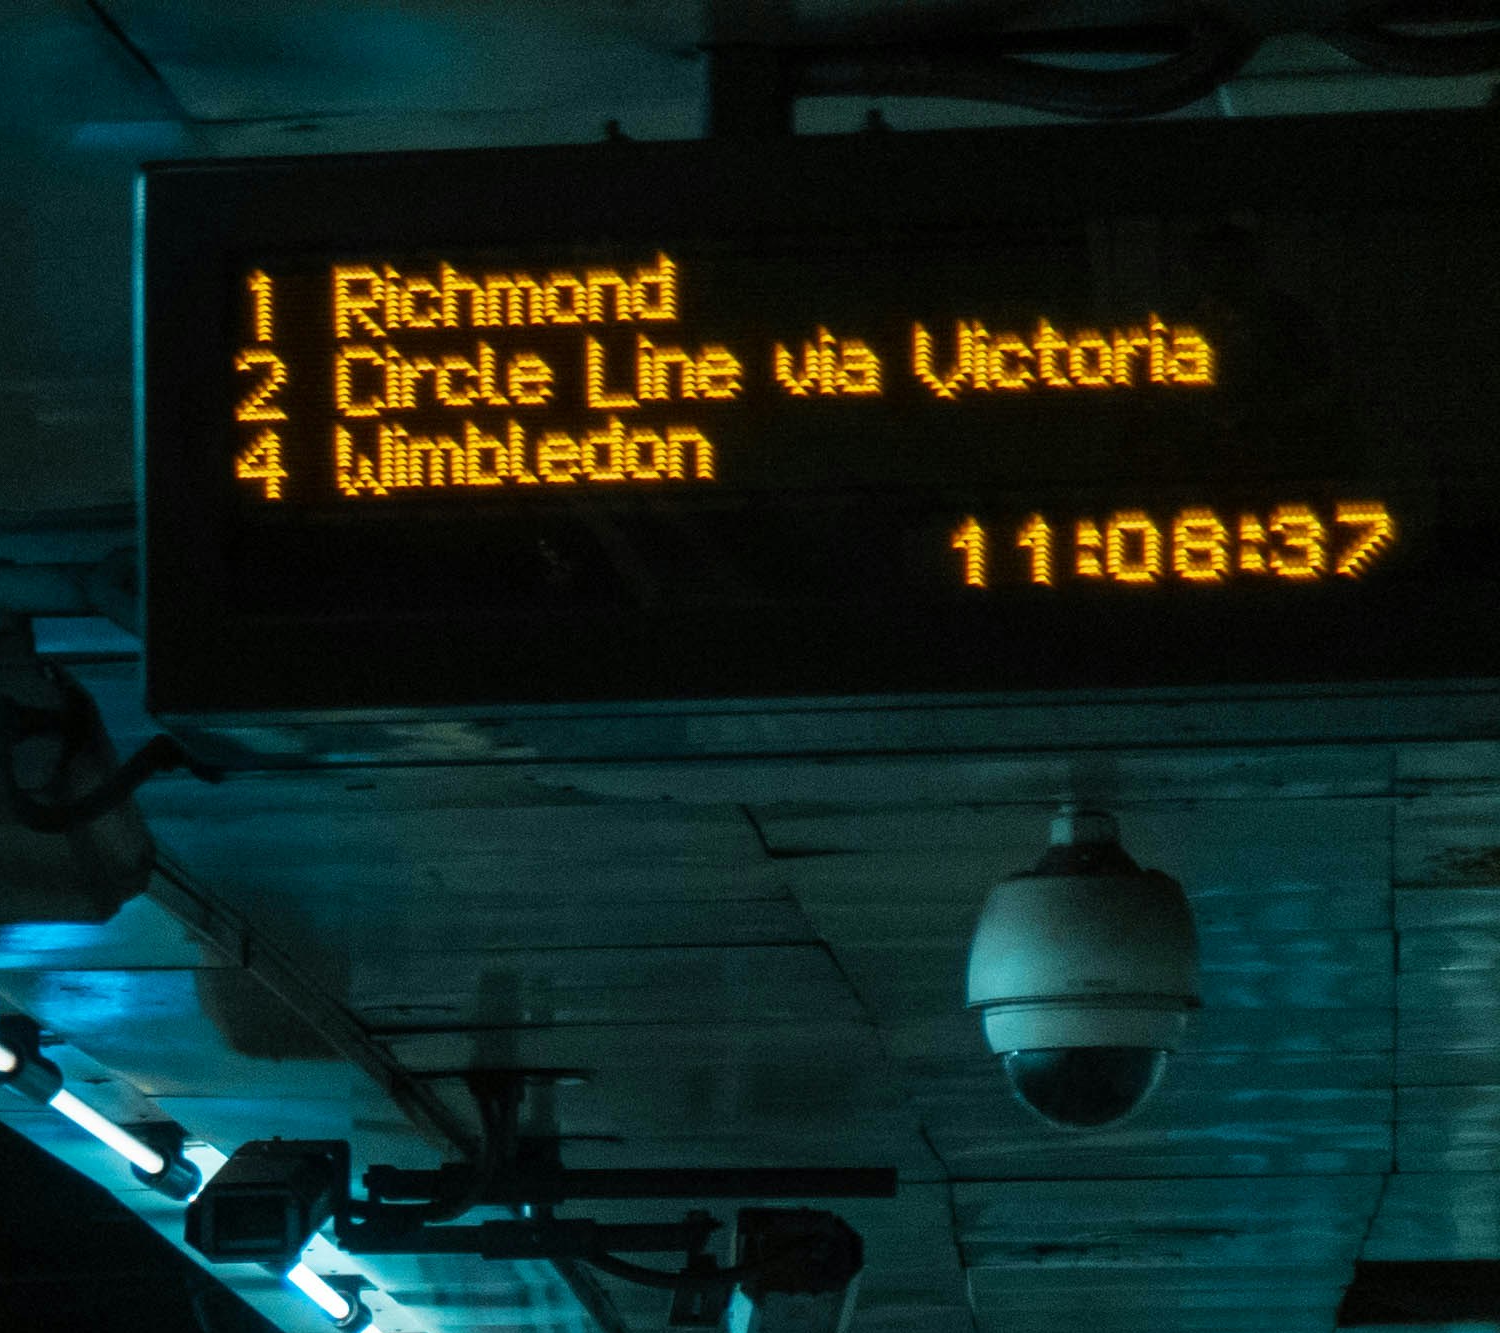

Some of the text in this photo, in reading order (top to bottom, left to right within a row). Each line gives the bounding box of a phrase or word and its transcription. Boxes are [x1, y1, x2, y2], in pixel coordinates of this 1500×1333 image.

[246, 252, 678, 342] 1 Richmond
[235, 311, 1215, 422] 2 Circle Line via Victoria
[235, 417, 714, 499] 4 Wimbledon
[951, 501, 1394, 587] 11:08:37
